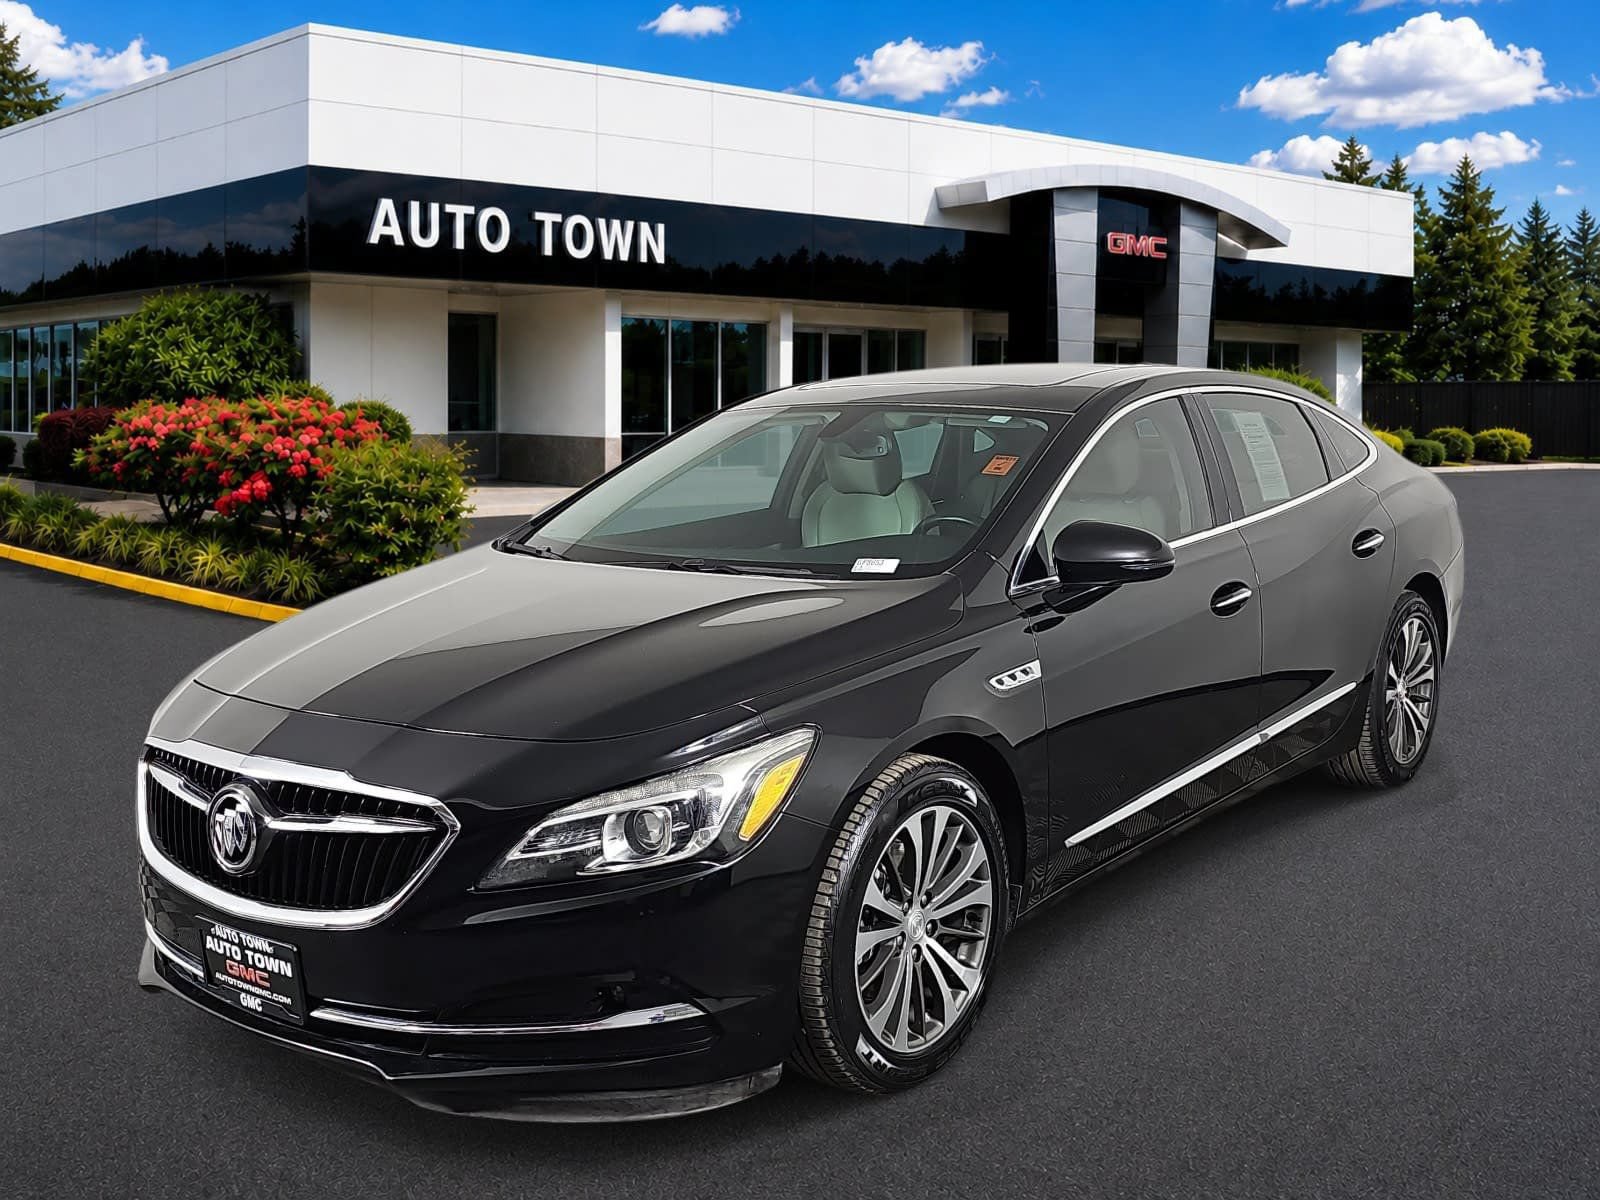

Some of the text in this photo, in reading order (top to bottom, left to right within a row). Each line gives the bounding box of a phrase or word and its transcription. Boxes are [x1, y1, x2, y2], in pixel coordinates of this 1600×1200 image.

[367, 198, 666, 264] AUTO TOWN
[1107, 232, 1168, 259] GMC
[215, 924, 271, 954] AUTO TOWN
[206, 935, 293, 978] AUTO TOWN
[226, 959, 271, 988] GMC
[215, 972, 292, 1006] AUTOTOWNGMC.COM
[240, 992, 263, 1012] GMC
